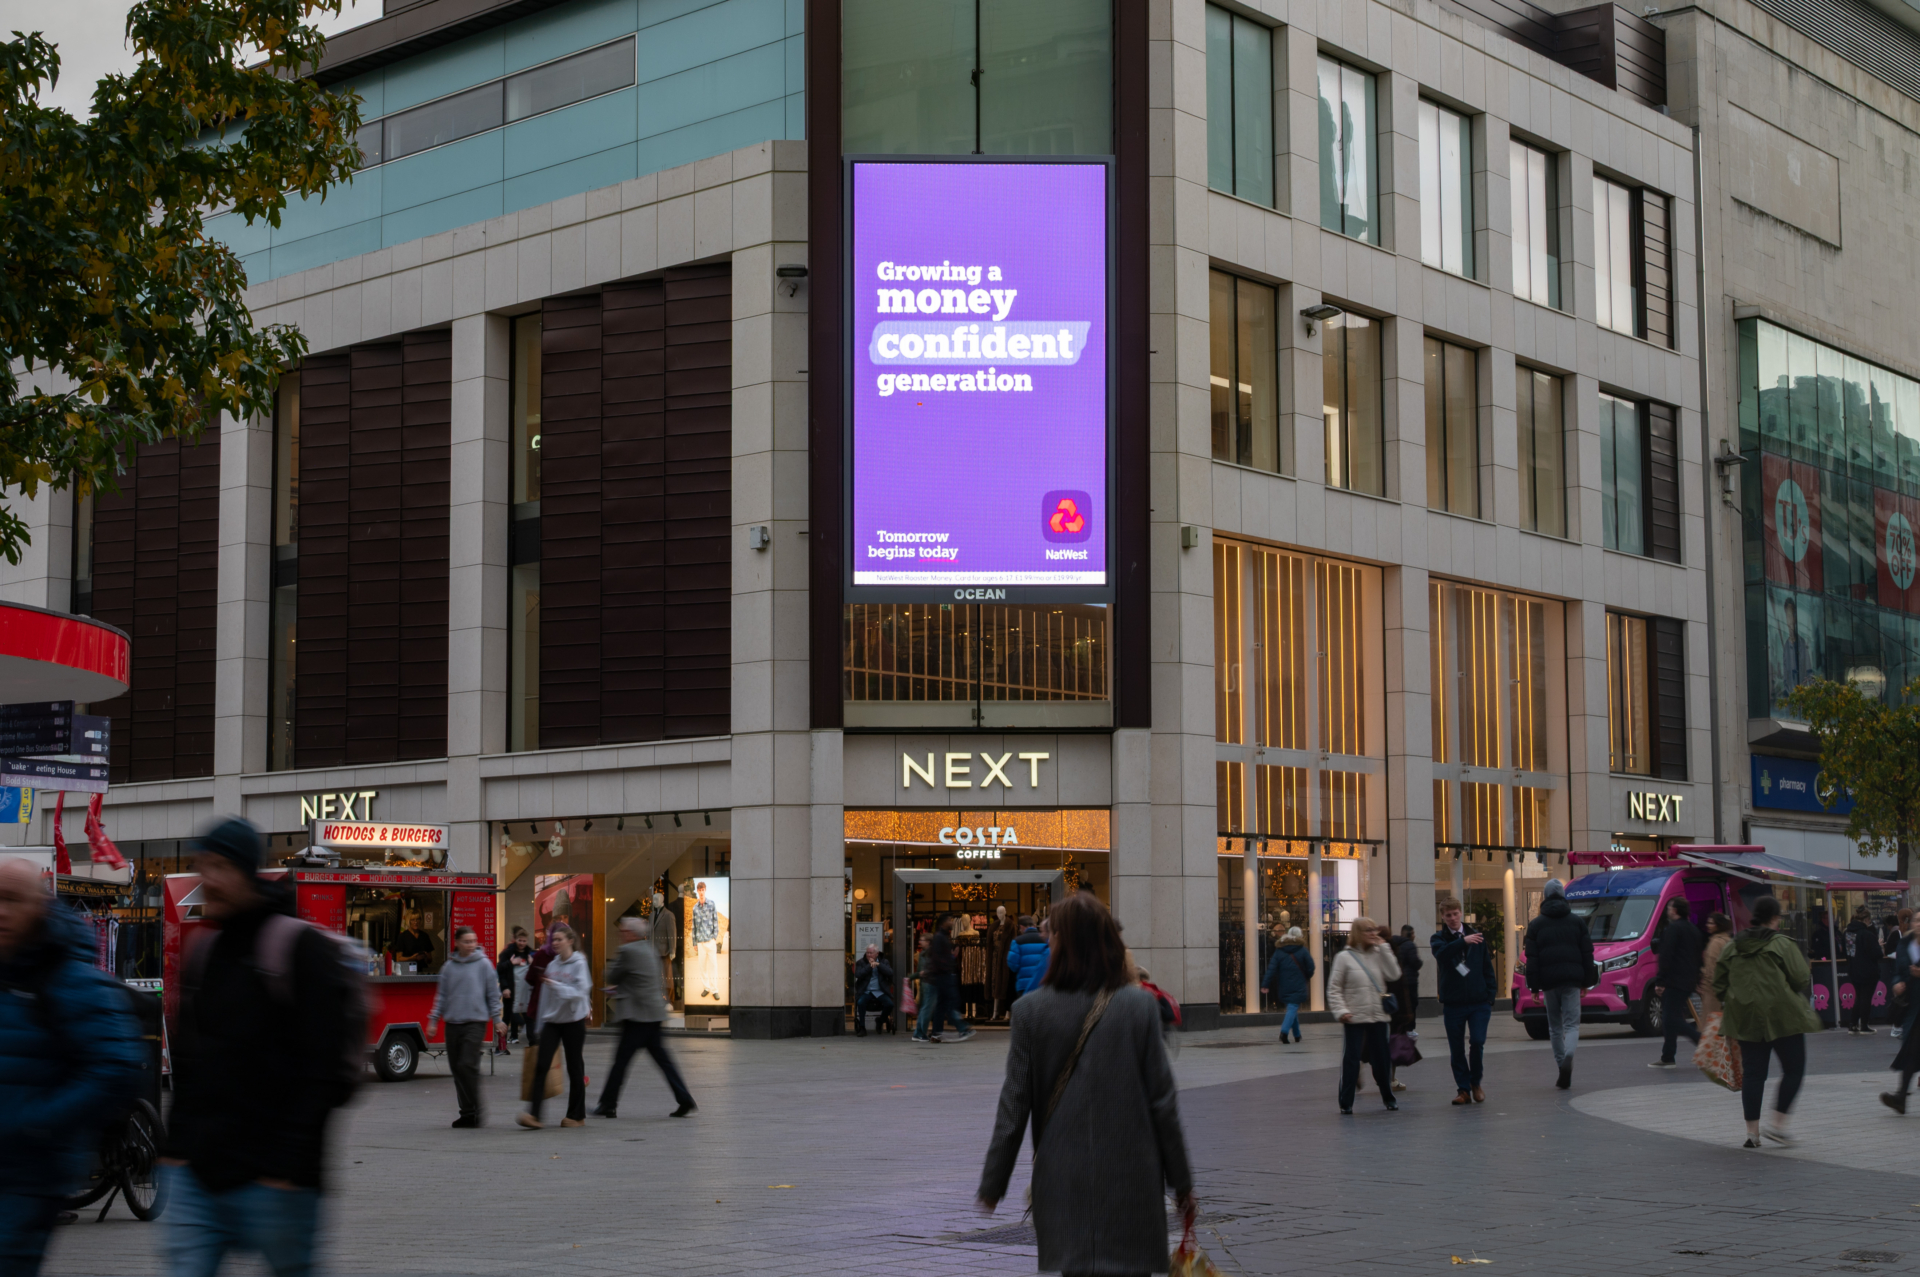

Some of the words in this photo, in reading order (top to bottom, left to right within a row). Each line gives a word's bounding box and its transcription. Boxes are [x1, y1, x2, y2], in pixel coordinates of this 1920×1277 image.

[877, 260, 982, 285] Growing
[988, 266, 1002, 281] a
[877, 288, 1017, 321] money
[877, 324, 1073, 359] confident
[877, 367, 1033, 396] generation
[877, 530, 949, 543] Tomorrow
[1890, 532, 1912, 558] 70%
[868, 545, 916, 560] begins
[919, 546, 958, 560] today
[1046, 549, 1088, 560] NatWest
[1891, 554, 1912, 580] OFF
[954, 589, 1006, 600] OCEAN
[36, 764, 55, 774] eeting
[57, 765, 76, 774] House
[903, 752, 1050, 788] NEXT
[6, 776, 20, 785] Bold
[22, 778, 41, 786] Street
[1779, 778, 1806, 793] pharmacy
[301, 792, 377, 825] NEXT
[1628, 791, 1683, 822] NEXT
[324, 825, 375, 841] HOTDOGS
[380, 827, 388, 841] &
[392, 827, 442, 843] BURGERS
[938, 826, 1018, 847] COSTA
[956, 850, 1001, 859] COFFEE
[304, 872, 334, 881] BURGER
[339, 873, 360, 882] CHIPS
[369, 874, 397, 882] HOTDOG
[402, 875, 429, 883] BURGER
[437, 876, 457, 884] CHIPS
[462, 876, 488, 885] HOTDOG
[1566, 889, 1601, 898] octopus
